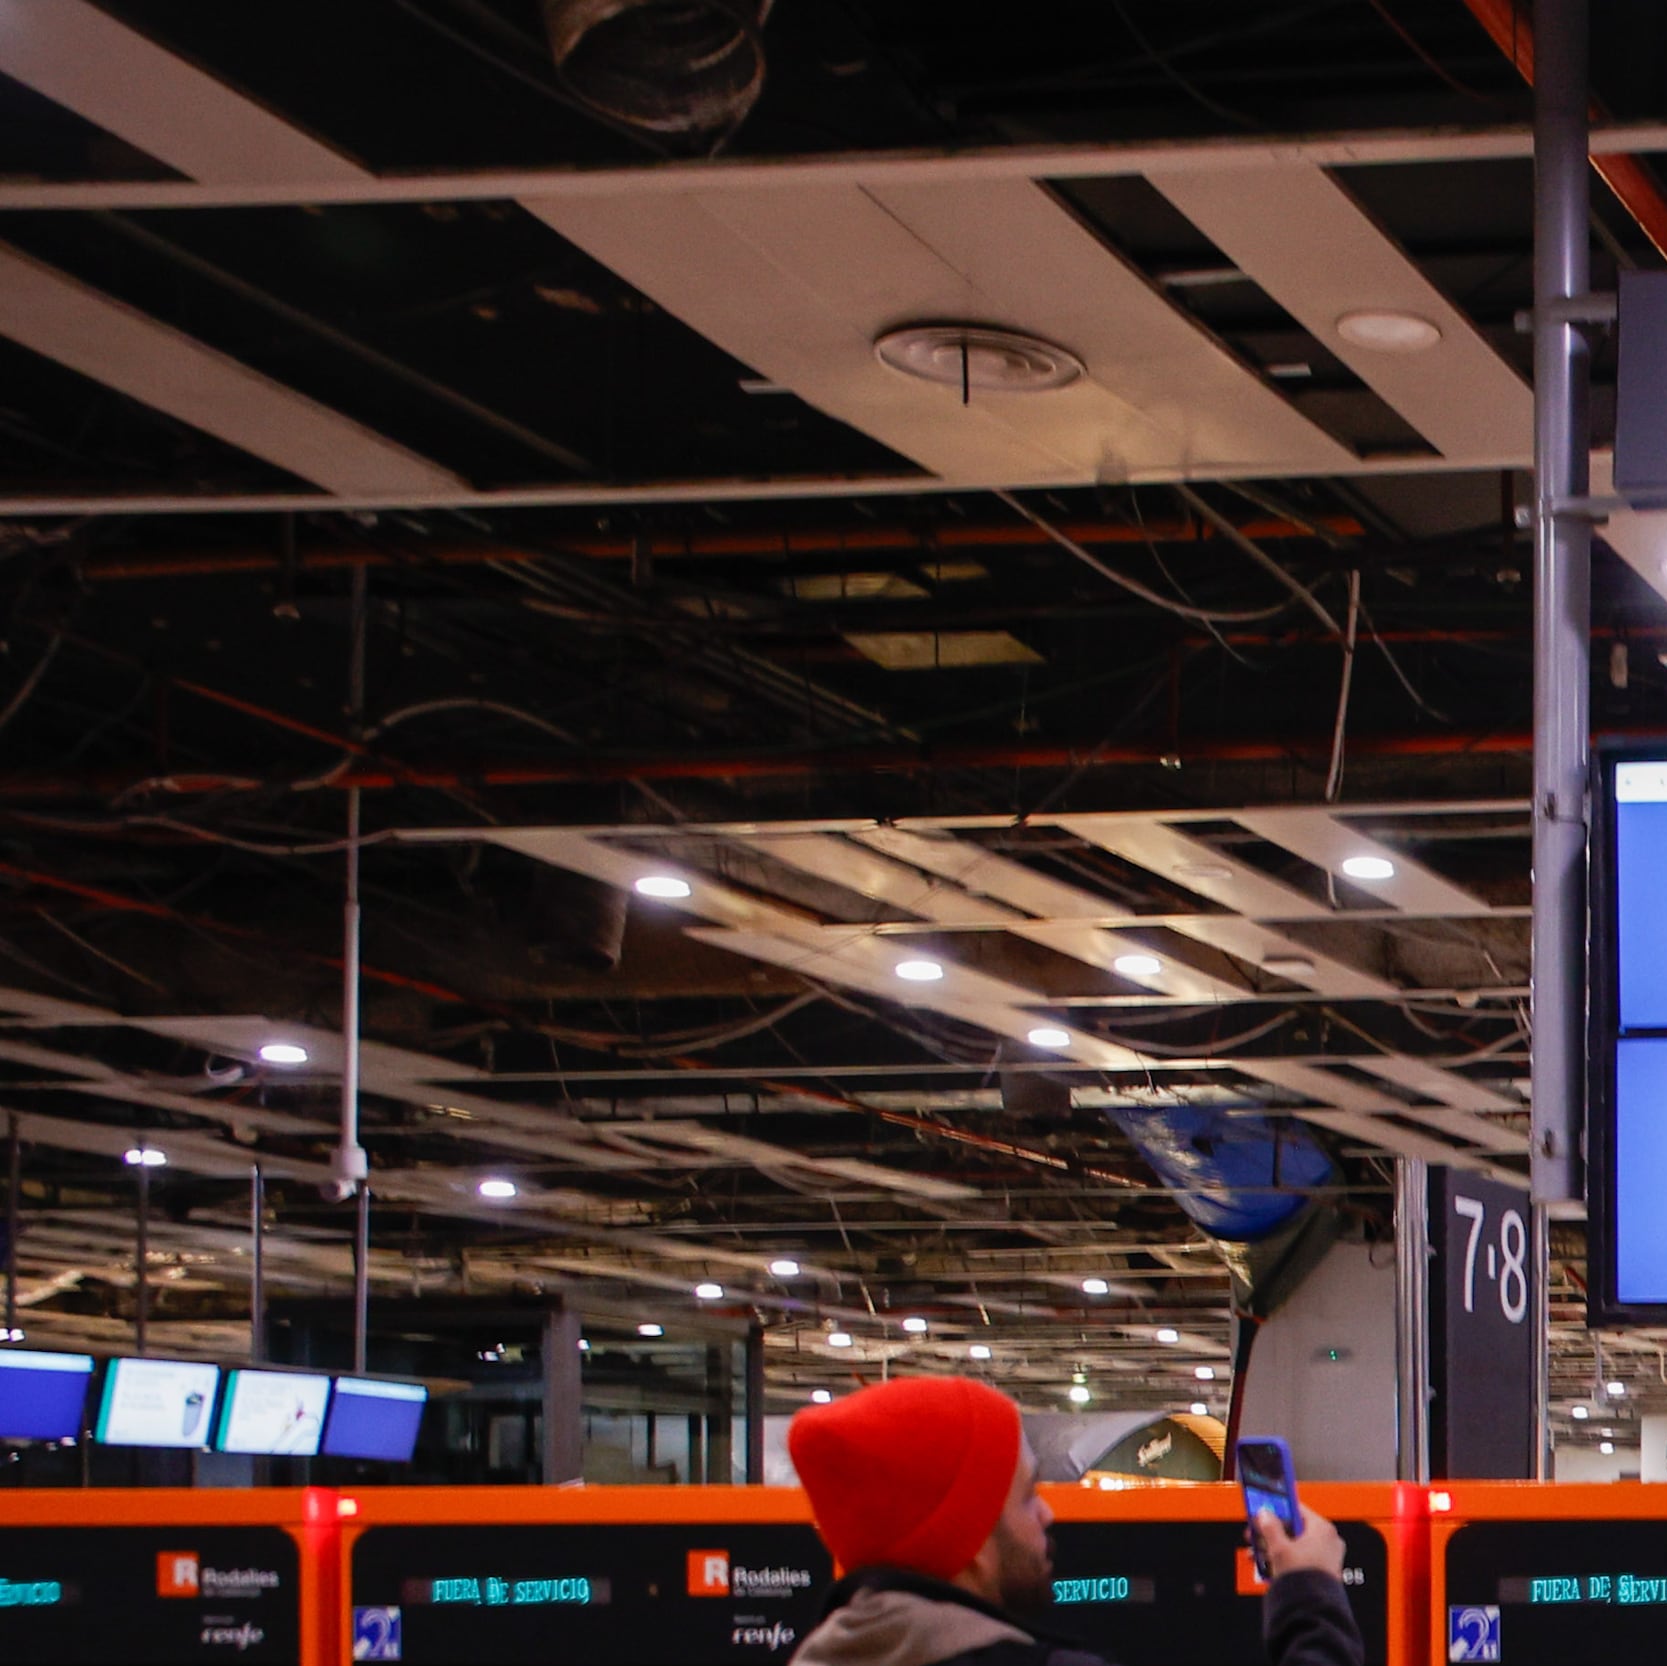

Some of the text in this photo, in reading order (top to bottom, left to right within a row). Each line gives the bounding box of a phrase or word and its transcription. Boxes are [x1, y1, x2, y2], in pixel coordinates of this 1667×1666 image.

[1051, 1576, 1128, 1604] SERVICIO
[1530, 1577, 1581, 1603] FUERA
[1589, 1575, 1612, 1603] DE
